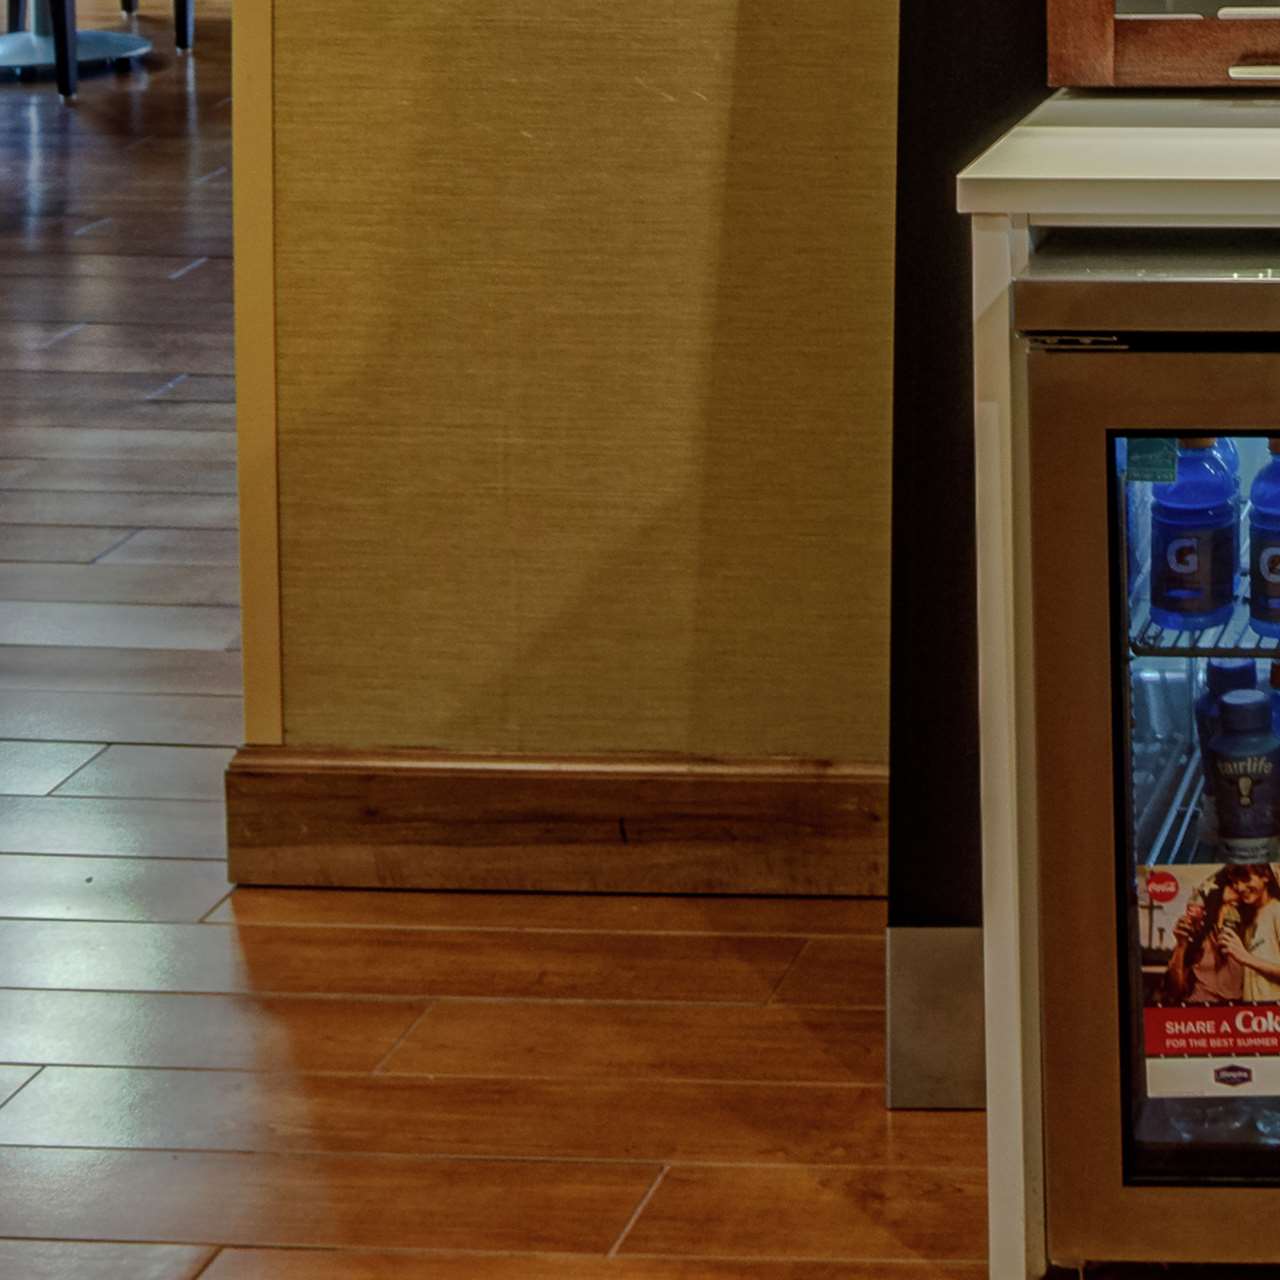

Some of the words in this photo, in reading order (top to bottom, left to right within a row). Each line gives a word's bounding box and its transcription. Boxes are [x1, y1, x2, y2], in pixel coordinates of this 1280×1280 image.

[1166, 538, 1199, 574] G
[1165, 1020, 1215, 1036] SHARE
[1219, 1020, 1231, 1033] A
[1166, 1038, 1187, 1049] FOR
[1188, 1037, 1208, 1048] THE
[1209, 1037, 1234, 1048] BEST
[1237, 1037, 1278, 1047] SUMMER
